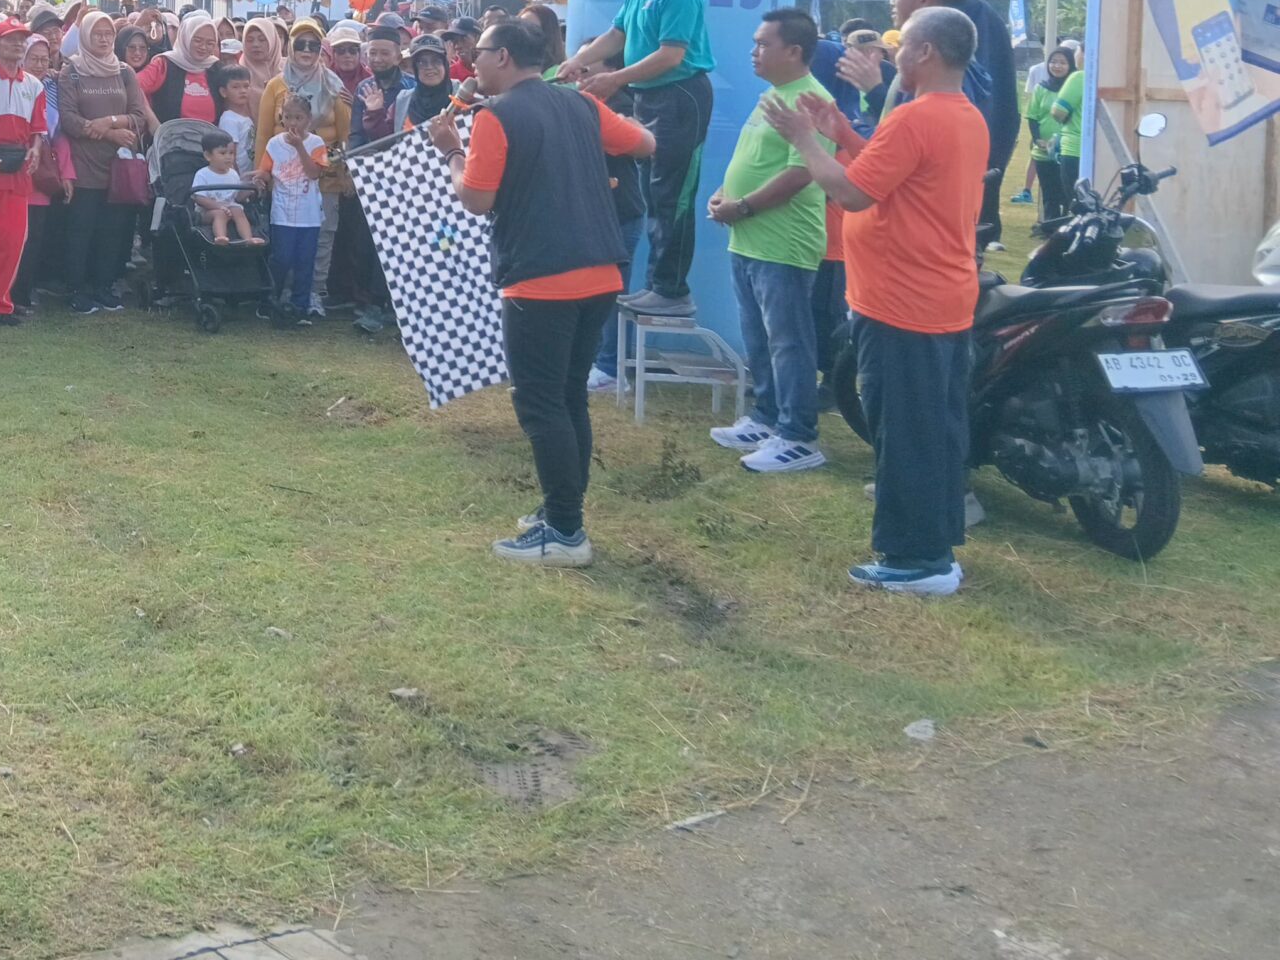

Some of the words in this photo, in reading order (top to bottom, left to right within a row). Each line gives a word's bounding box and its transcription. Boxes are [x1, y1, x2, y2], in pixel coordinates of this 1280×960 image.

[302, 179, 310, 194] 3
[1104, 357, 1122, 371] AB
[1129, 355, 1165, 369] 4342
